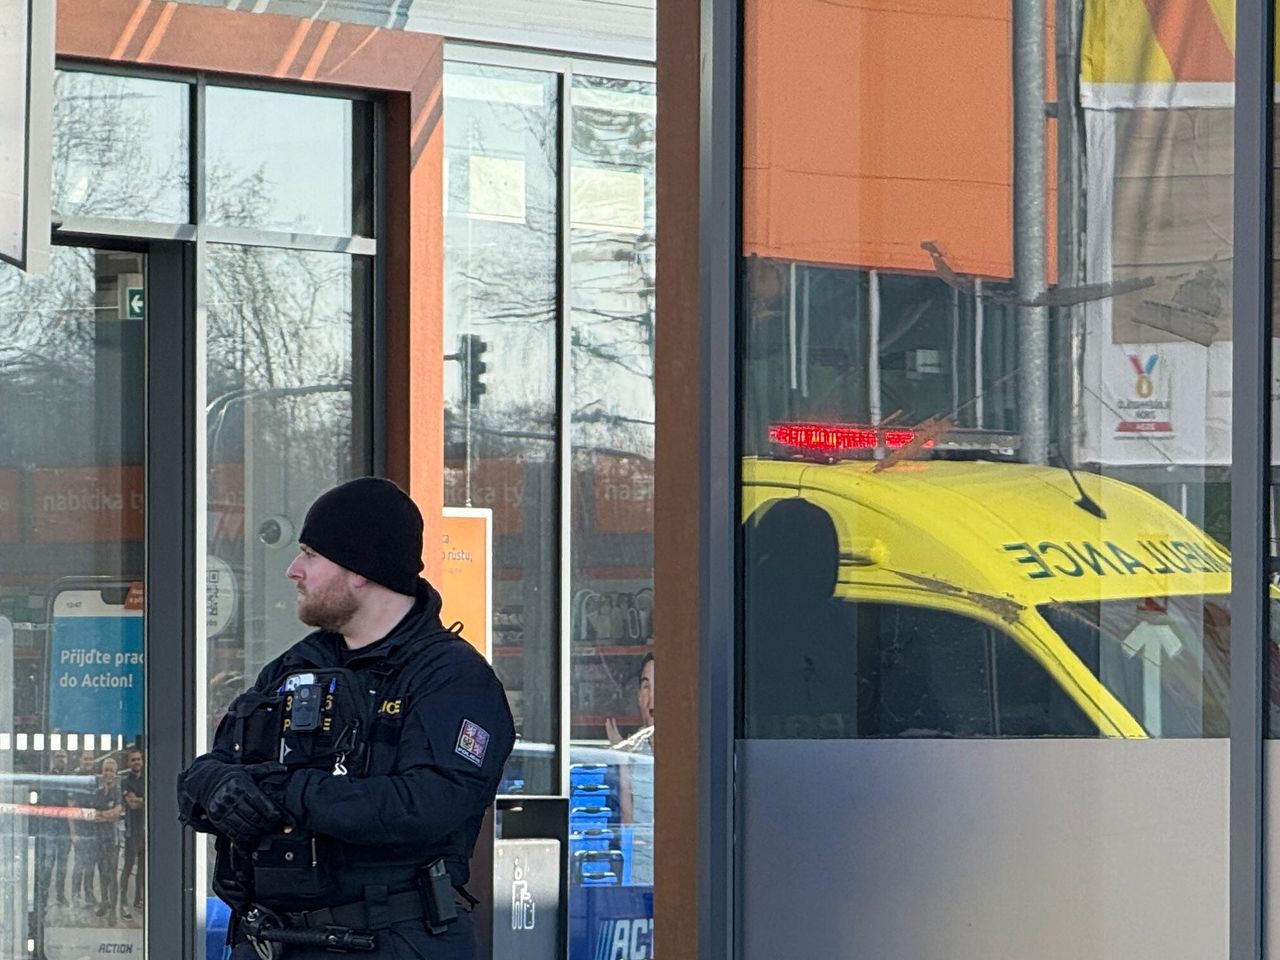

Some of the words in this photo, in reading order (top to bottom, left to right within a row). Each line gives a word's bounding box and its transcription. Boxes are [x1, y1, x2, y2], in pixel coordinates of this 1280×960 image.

[61, 649, 111, 667] Přijďte
[60, 672, 77, 687] do
[81, 672, 132, 687] Action!
[98, 943, 133, 954] ACTION
